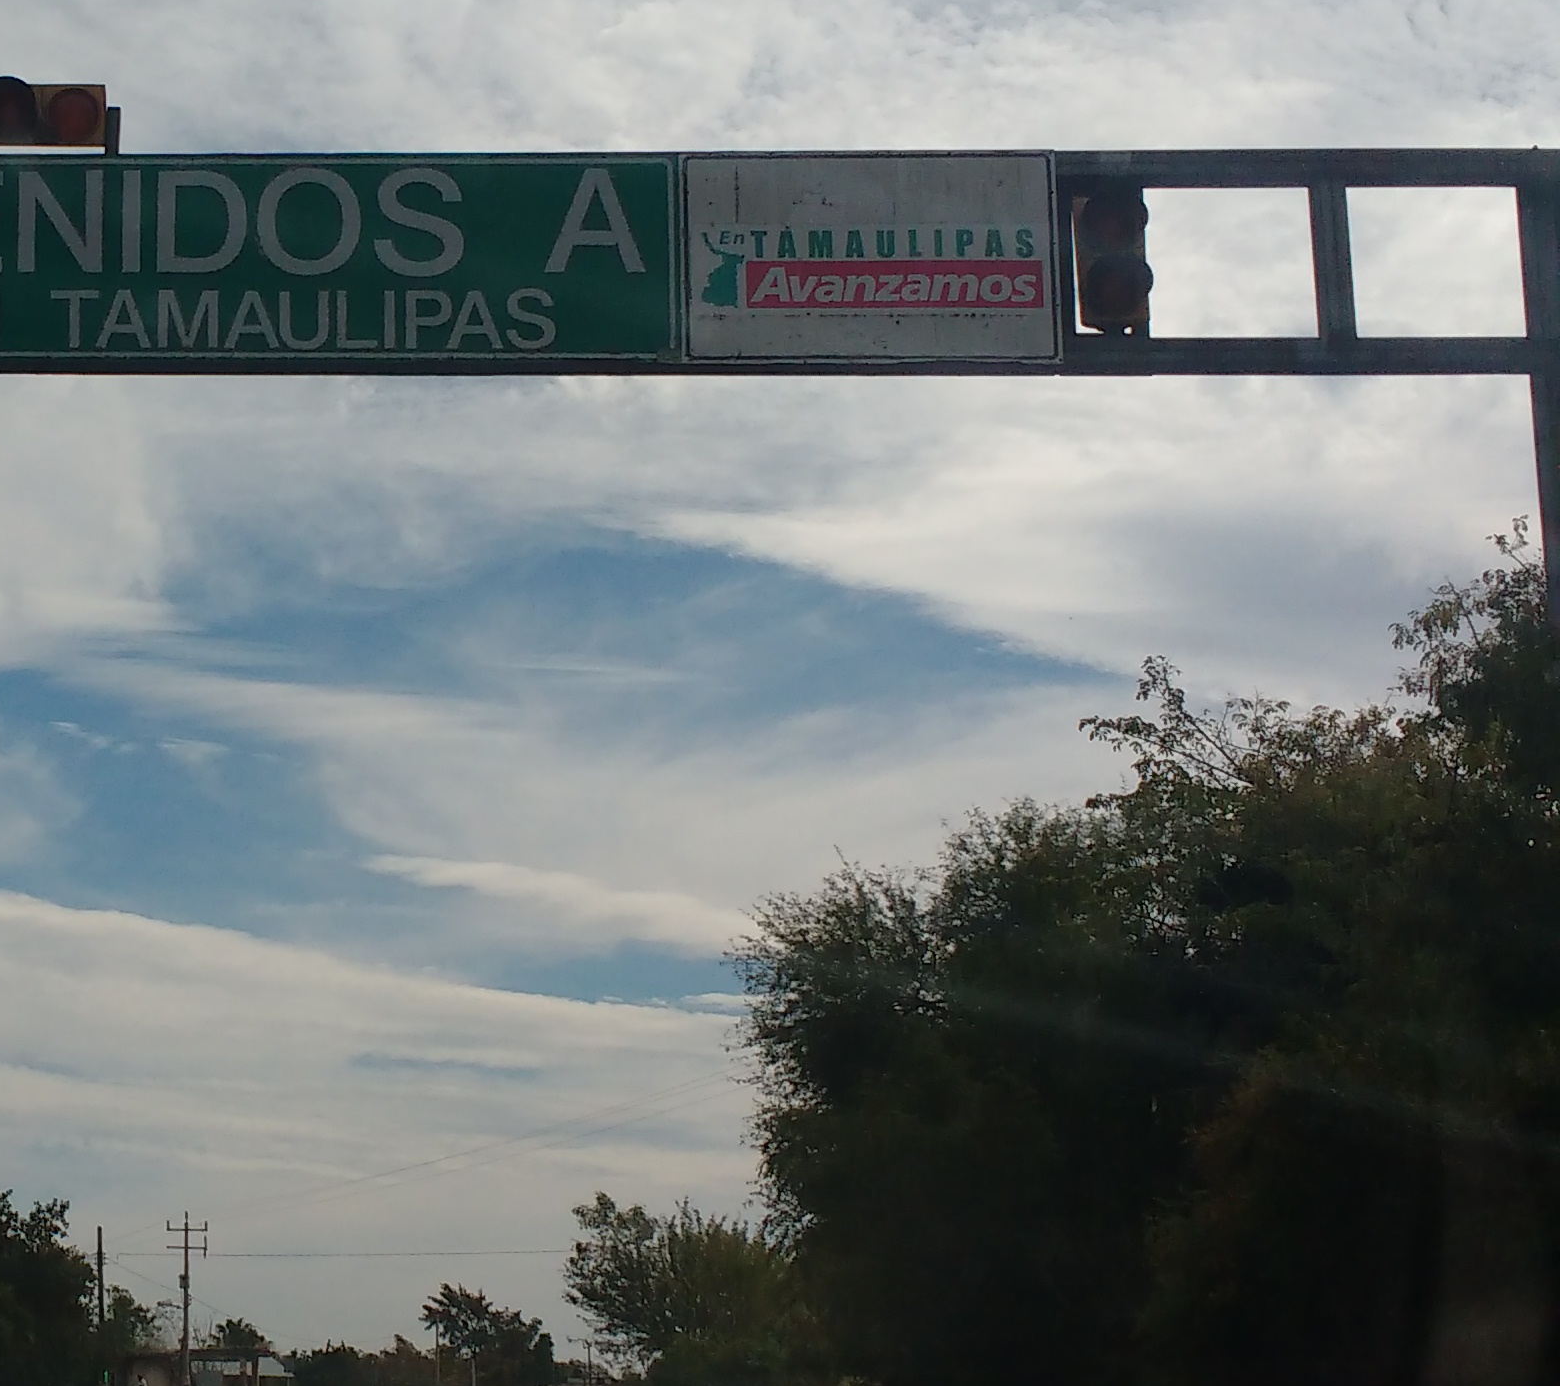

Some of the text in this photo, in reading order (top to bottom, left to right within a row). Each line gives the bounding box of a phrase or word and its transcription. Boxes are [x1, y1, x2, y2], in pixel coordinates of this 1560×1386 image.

[544, 168, 645, 274] A
[718, 229, 1035, 258] En TAMAULIPAS
[750, 267, 1037, 303] Avanzamos
[51, 288, 558, 351] TAMAULIPAS
